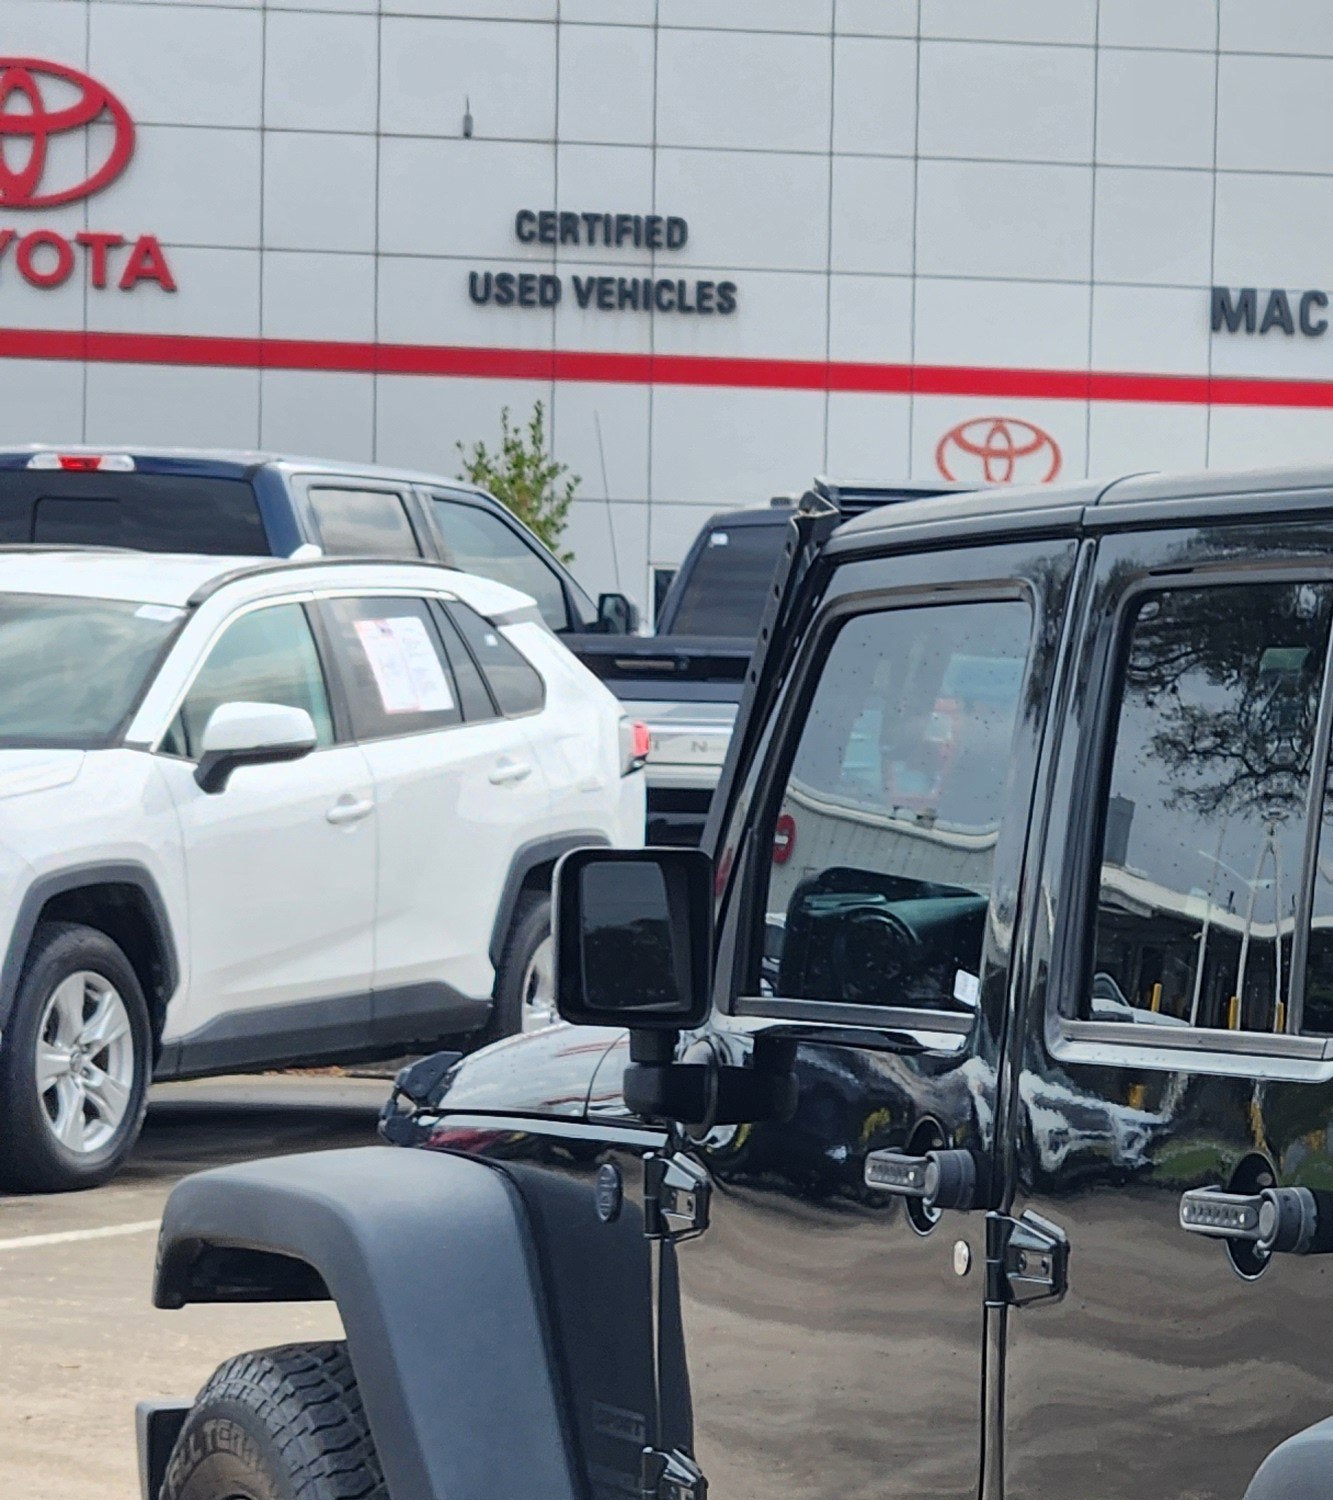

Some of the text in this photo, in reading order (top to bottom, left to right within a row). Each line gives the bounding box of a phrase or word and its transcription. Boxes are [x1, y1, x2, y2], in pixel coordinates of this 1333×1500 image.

[514, 208, 690, 252] CERTIFIED
[0, 228, 178, 293] OTA
[468, 270, 739, 315] USED VEHICLES
[1209, 284, 1328, 339] MAC
